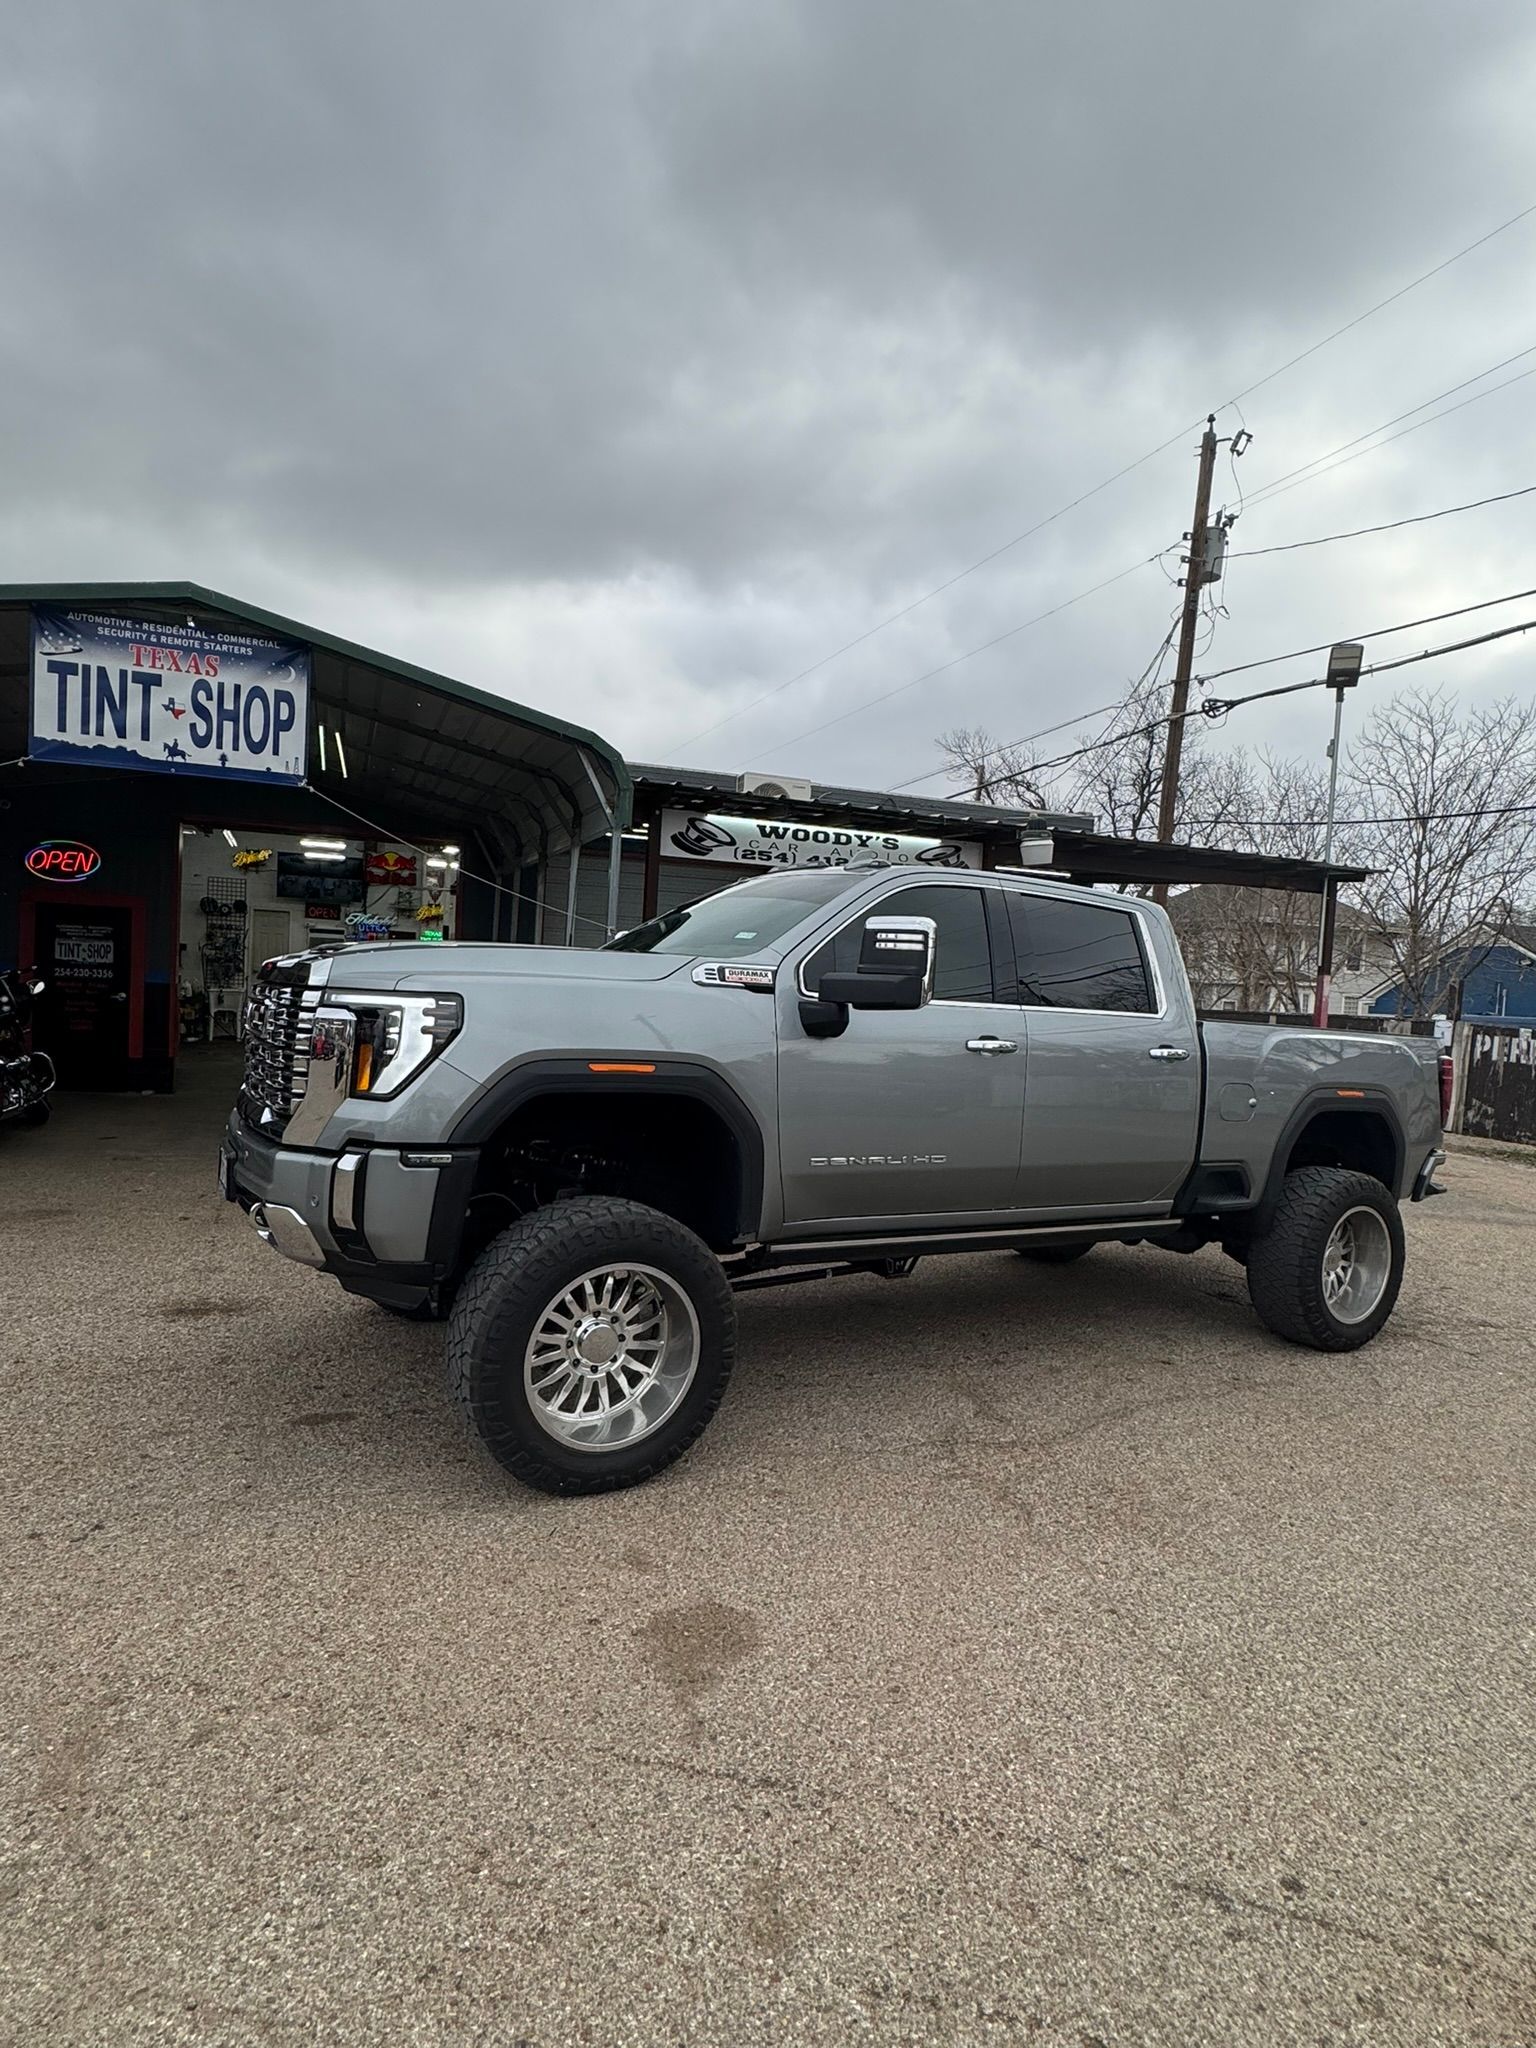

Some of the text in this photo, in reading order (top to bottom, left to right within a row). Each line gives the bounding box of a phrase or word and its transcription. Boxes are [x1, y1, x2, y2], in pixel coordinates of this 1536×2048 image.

[67, 611, 280, 649] AUTOMOTIVE RESIDENTIAL COMMERCIAL
[97, 626, 253, 655] SECURITY & REMOTE STARTERS
[128, 643, 220, 678] TEXAS
[47, 660, 296, 756] TINT SHOP
[756, 824, 900, 850] WOODY'S
[29, 849, 94, 872] OPEN
[733, 847, 797, 865] (254)
[748, 839, 909, 863] CAR ADIO
[308, 906, 338, 919] OPEN
[56, 943, 112, 959] TINT SHOP
[728, 969, 769, 978] DURAMAX
[810, 1154, 947, 1166] DENALI HD
